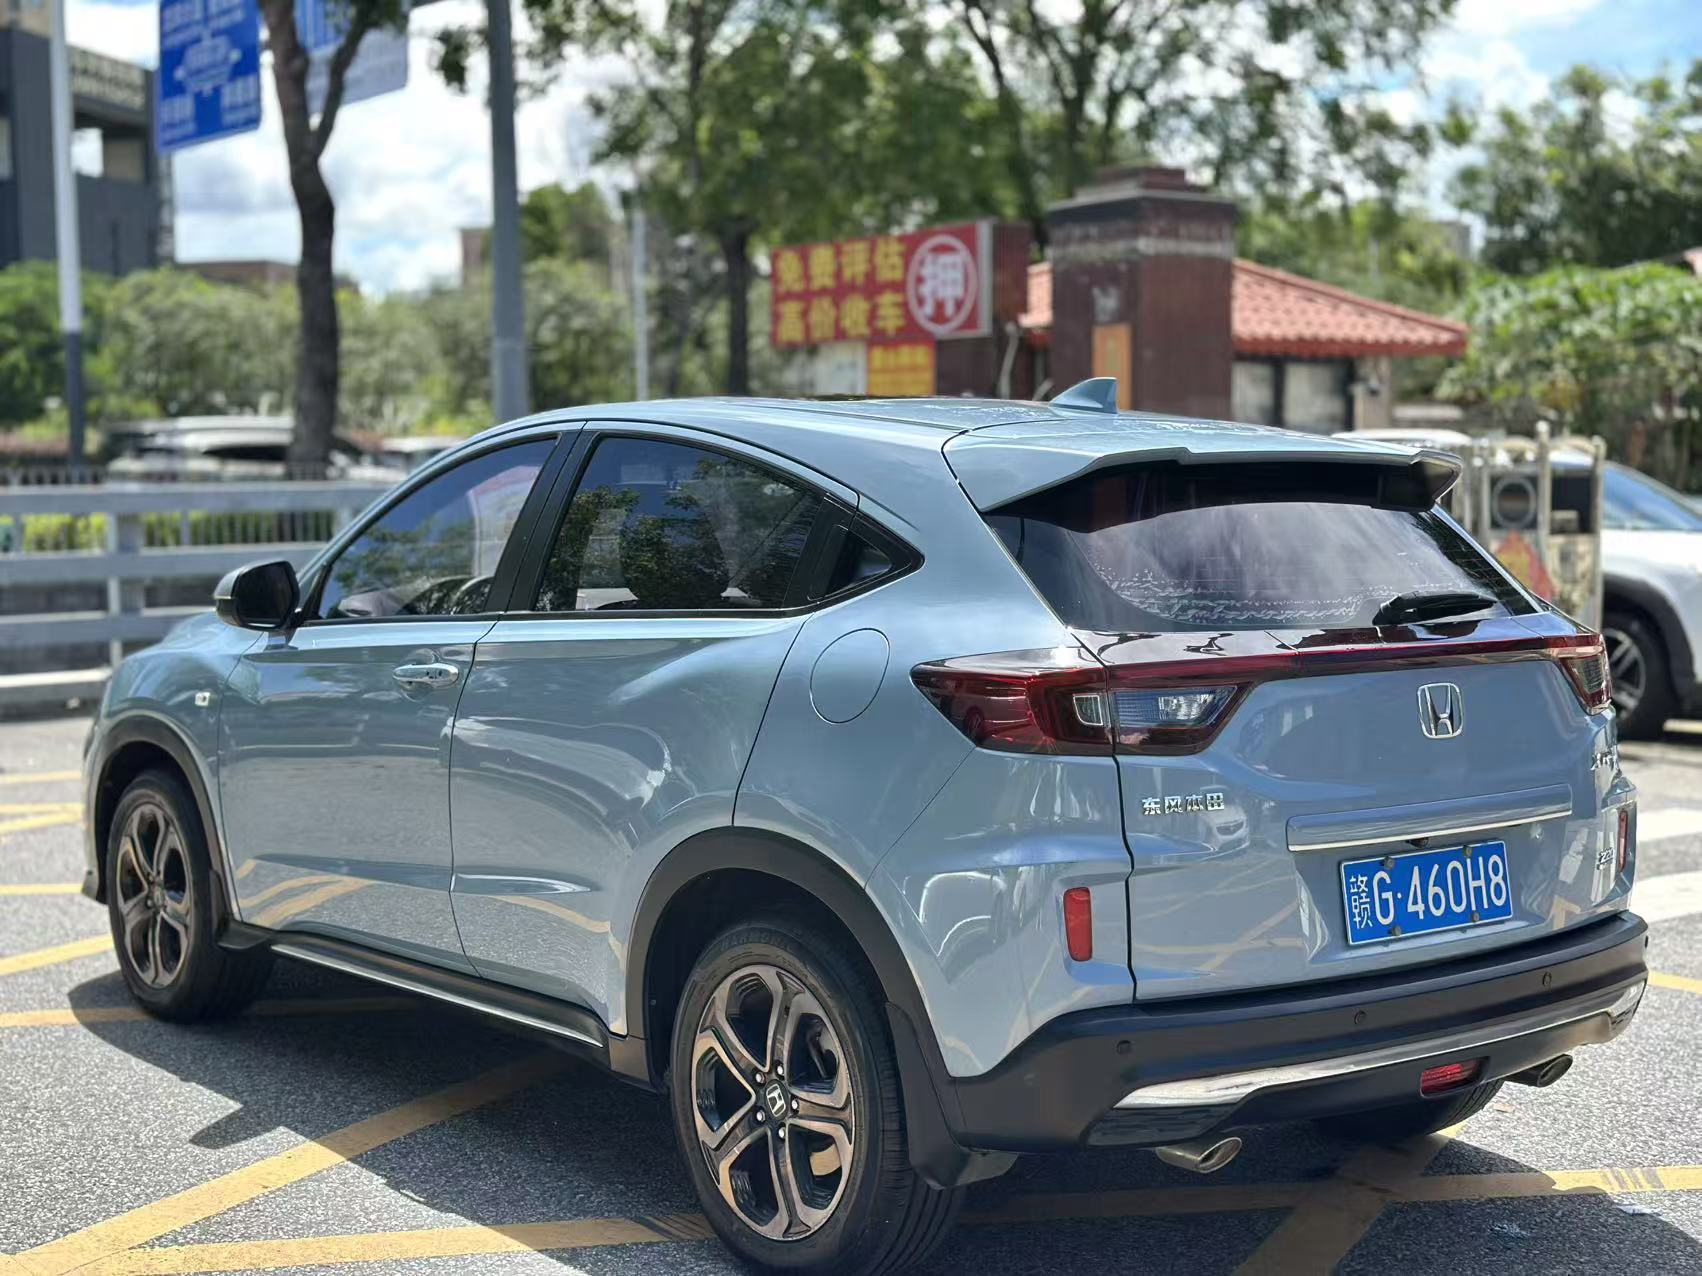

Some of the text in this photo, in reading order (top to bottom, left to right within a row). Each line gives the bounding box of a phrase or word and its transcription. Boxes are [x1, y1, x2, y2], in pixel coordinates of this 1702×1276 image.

[917, 251, 967, 319] 押
[1142, 792, 1225, 815] 东风本田
